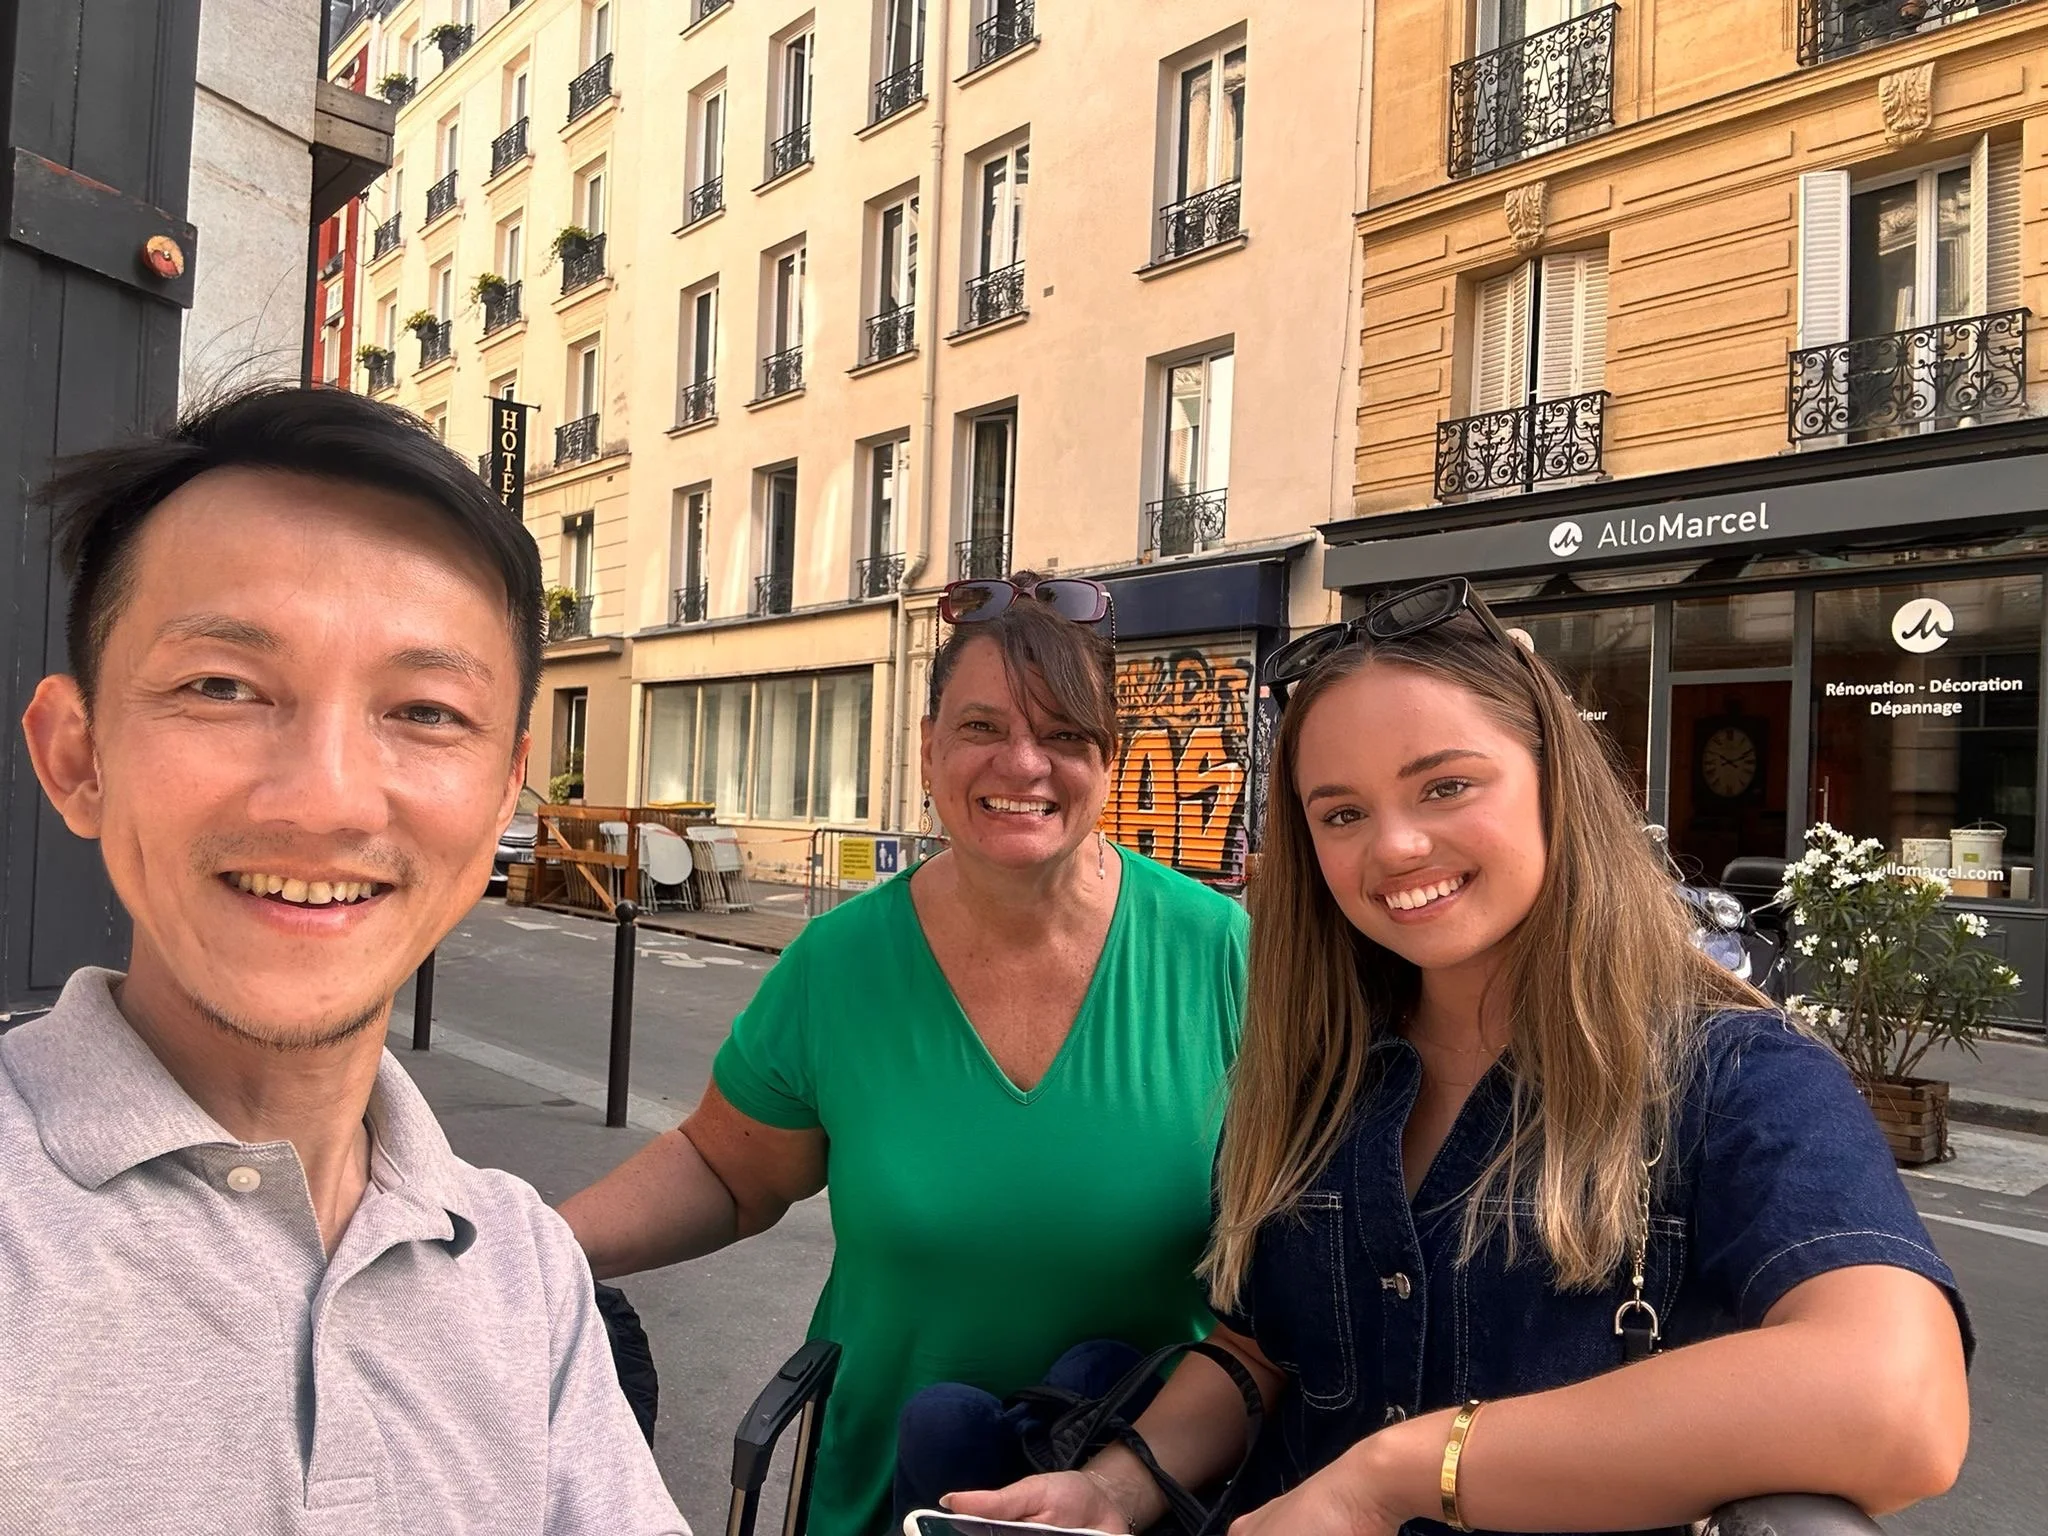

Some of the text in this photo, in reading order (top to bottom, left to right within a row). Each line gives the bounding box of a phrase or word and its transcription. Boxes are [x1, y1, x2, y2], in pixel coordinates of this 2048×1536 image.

[1597, 502, 1770, 549] AlloMarcel
[1825, 680, 1915, 697] Rénovation
[1929, 677, 2023, 694] Décoration
[1577, 708, 1608, 721] rieur
[1870, 700, 1963, 717] Dépannage
